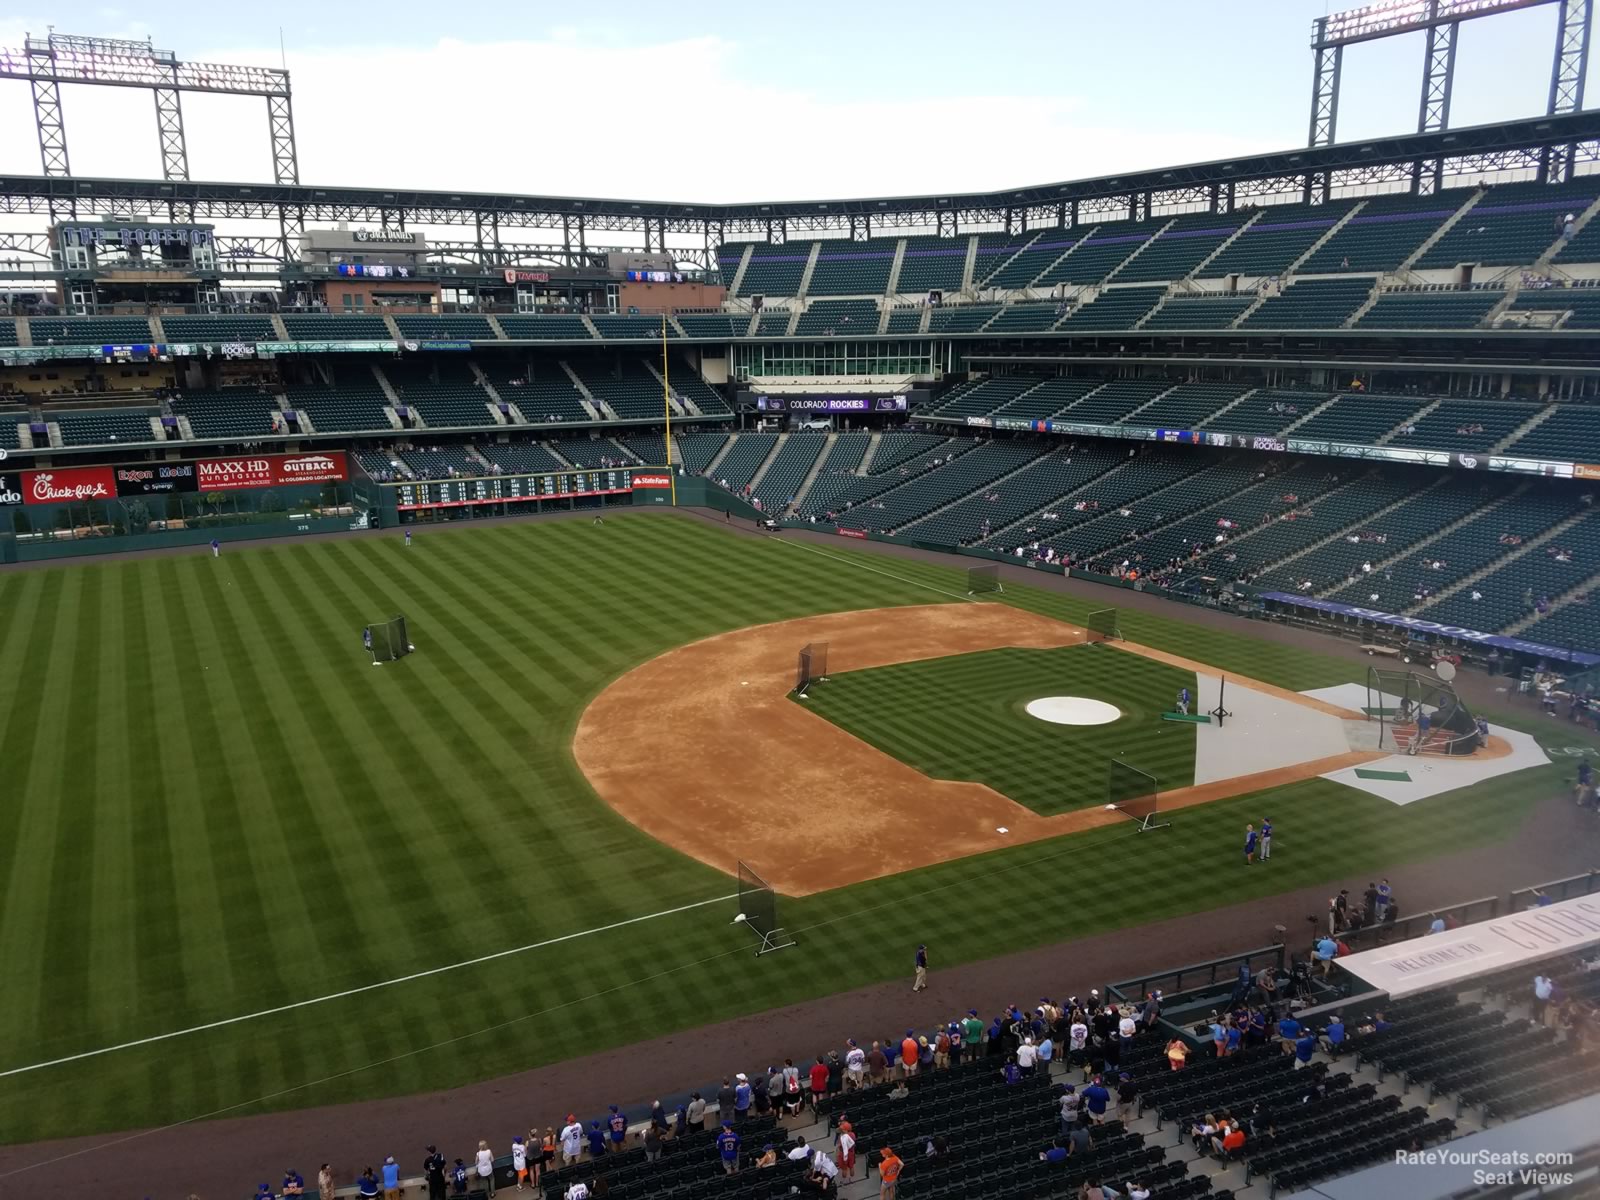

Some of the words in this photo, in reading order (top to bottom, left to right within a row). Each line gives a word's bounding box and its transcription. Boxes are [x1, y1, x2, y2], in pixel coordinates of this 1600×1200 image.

[64, 228, 106, 245] THE
[120, 228, 214, 246] ROOFTOP
[1253, 441, 1285, 451] ROCKIES
[118, 470, 153, 482] Exxon
[159, 467, 192, 477] Mobil
[199, 461, 245, 475] MAXX
[247, 460, 269, 472] HD
[284, 462, 335, 472] OUTBACK
[200, 472, 270, 482] sunglasses
[33, 474, 108, 500] Chick-fil-A
[1391, 949, 1463, 973] WELCOME
[1460, 943, 1484, 955] TO
[724, 1143, 734, 1151] 13
